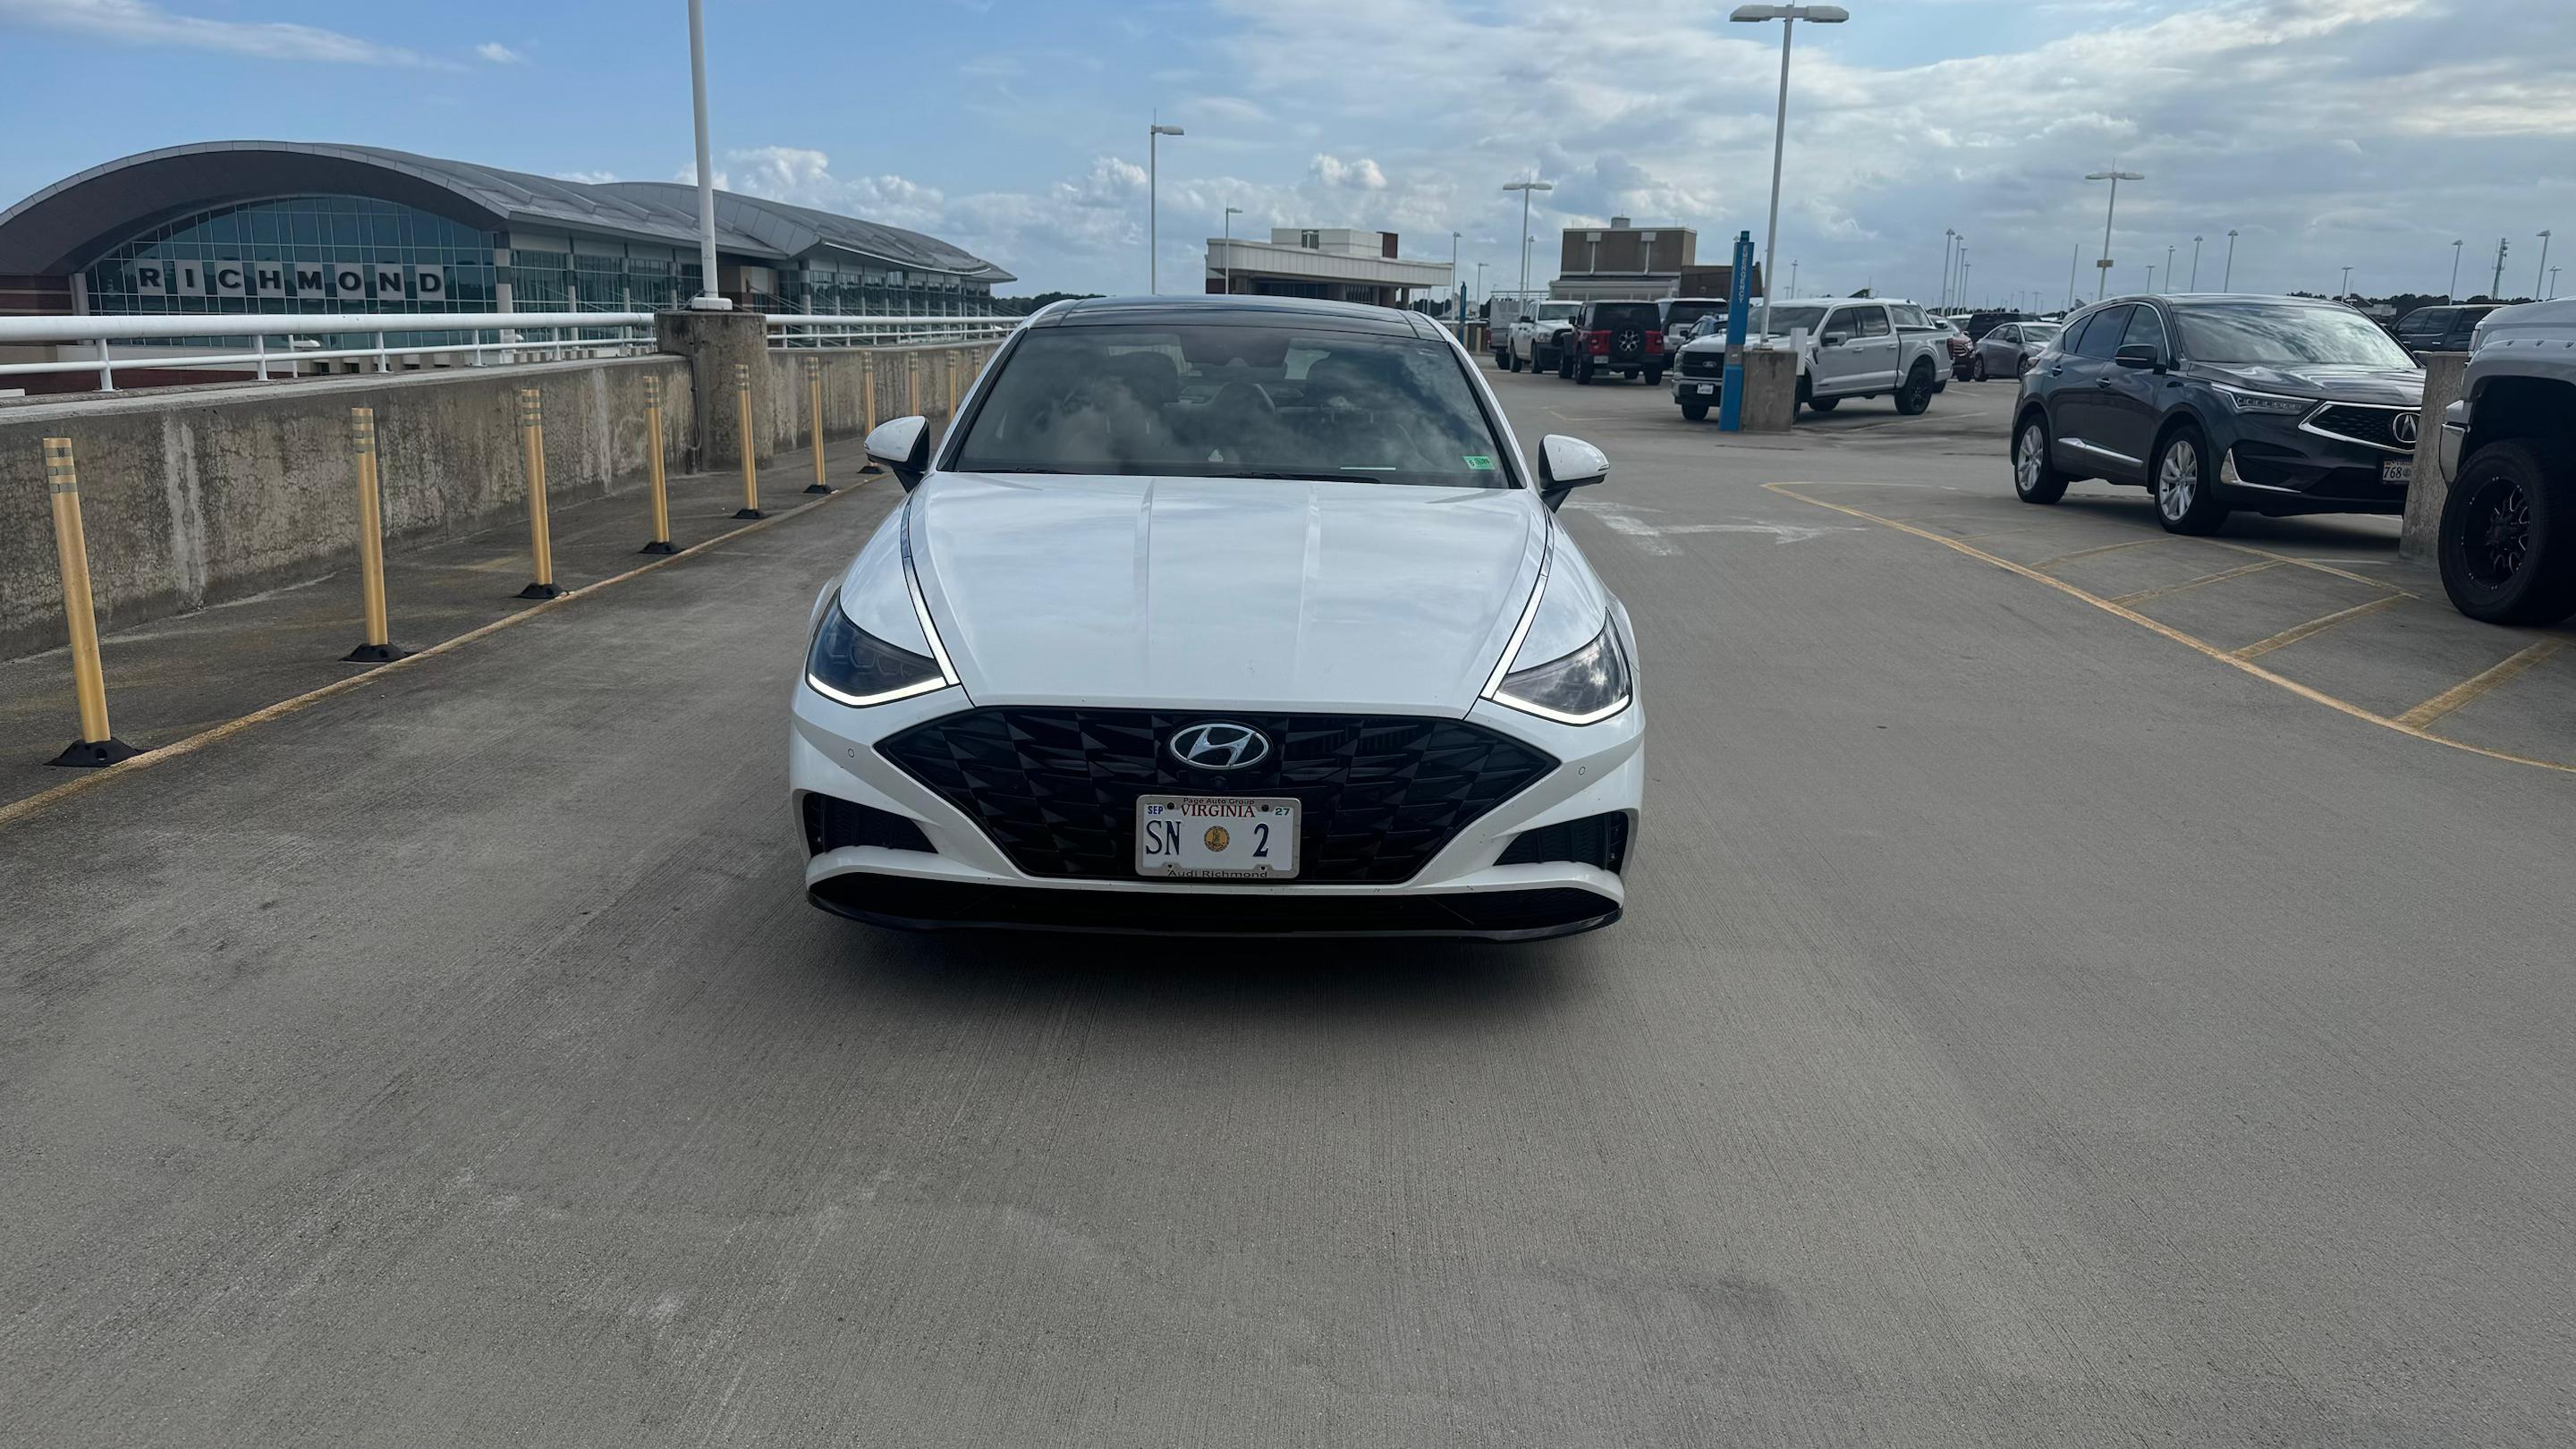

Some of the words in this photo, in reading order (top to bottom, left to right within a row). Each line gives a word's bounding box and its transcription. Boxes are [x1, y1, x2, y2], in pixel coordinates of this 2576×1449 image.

[138, 267, 443, 293] RICHMOND
[1739, 245, 1749, 303] EMERGENCY
[2384, 466, 2402, 479] 768
[1183, 797, 1204, 805] Page
[1148, 805, 1164, 815] SEP
[1181, 804, 1256, 818] VIRGINIA
[1275, 808, 1291, 816] 27
[1146, 819, 1182, 856] SN
[1252, 823, 1269, 857] 2
[1167, 869, 1198, 877] Audi
[1202, 870, 1267, 878] Richmond
